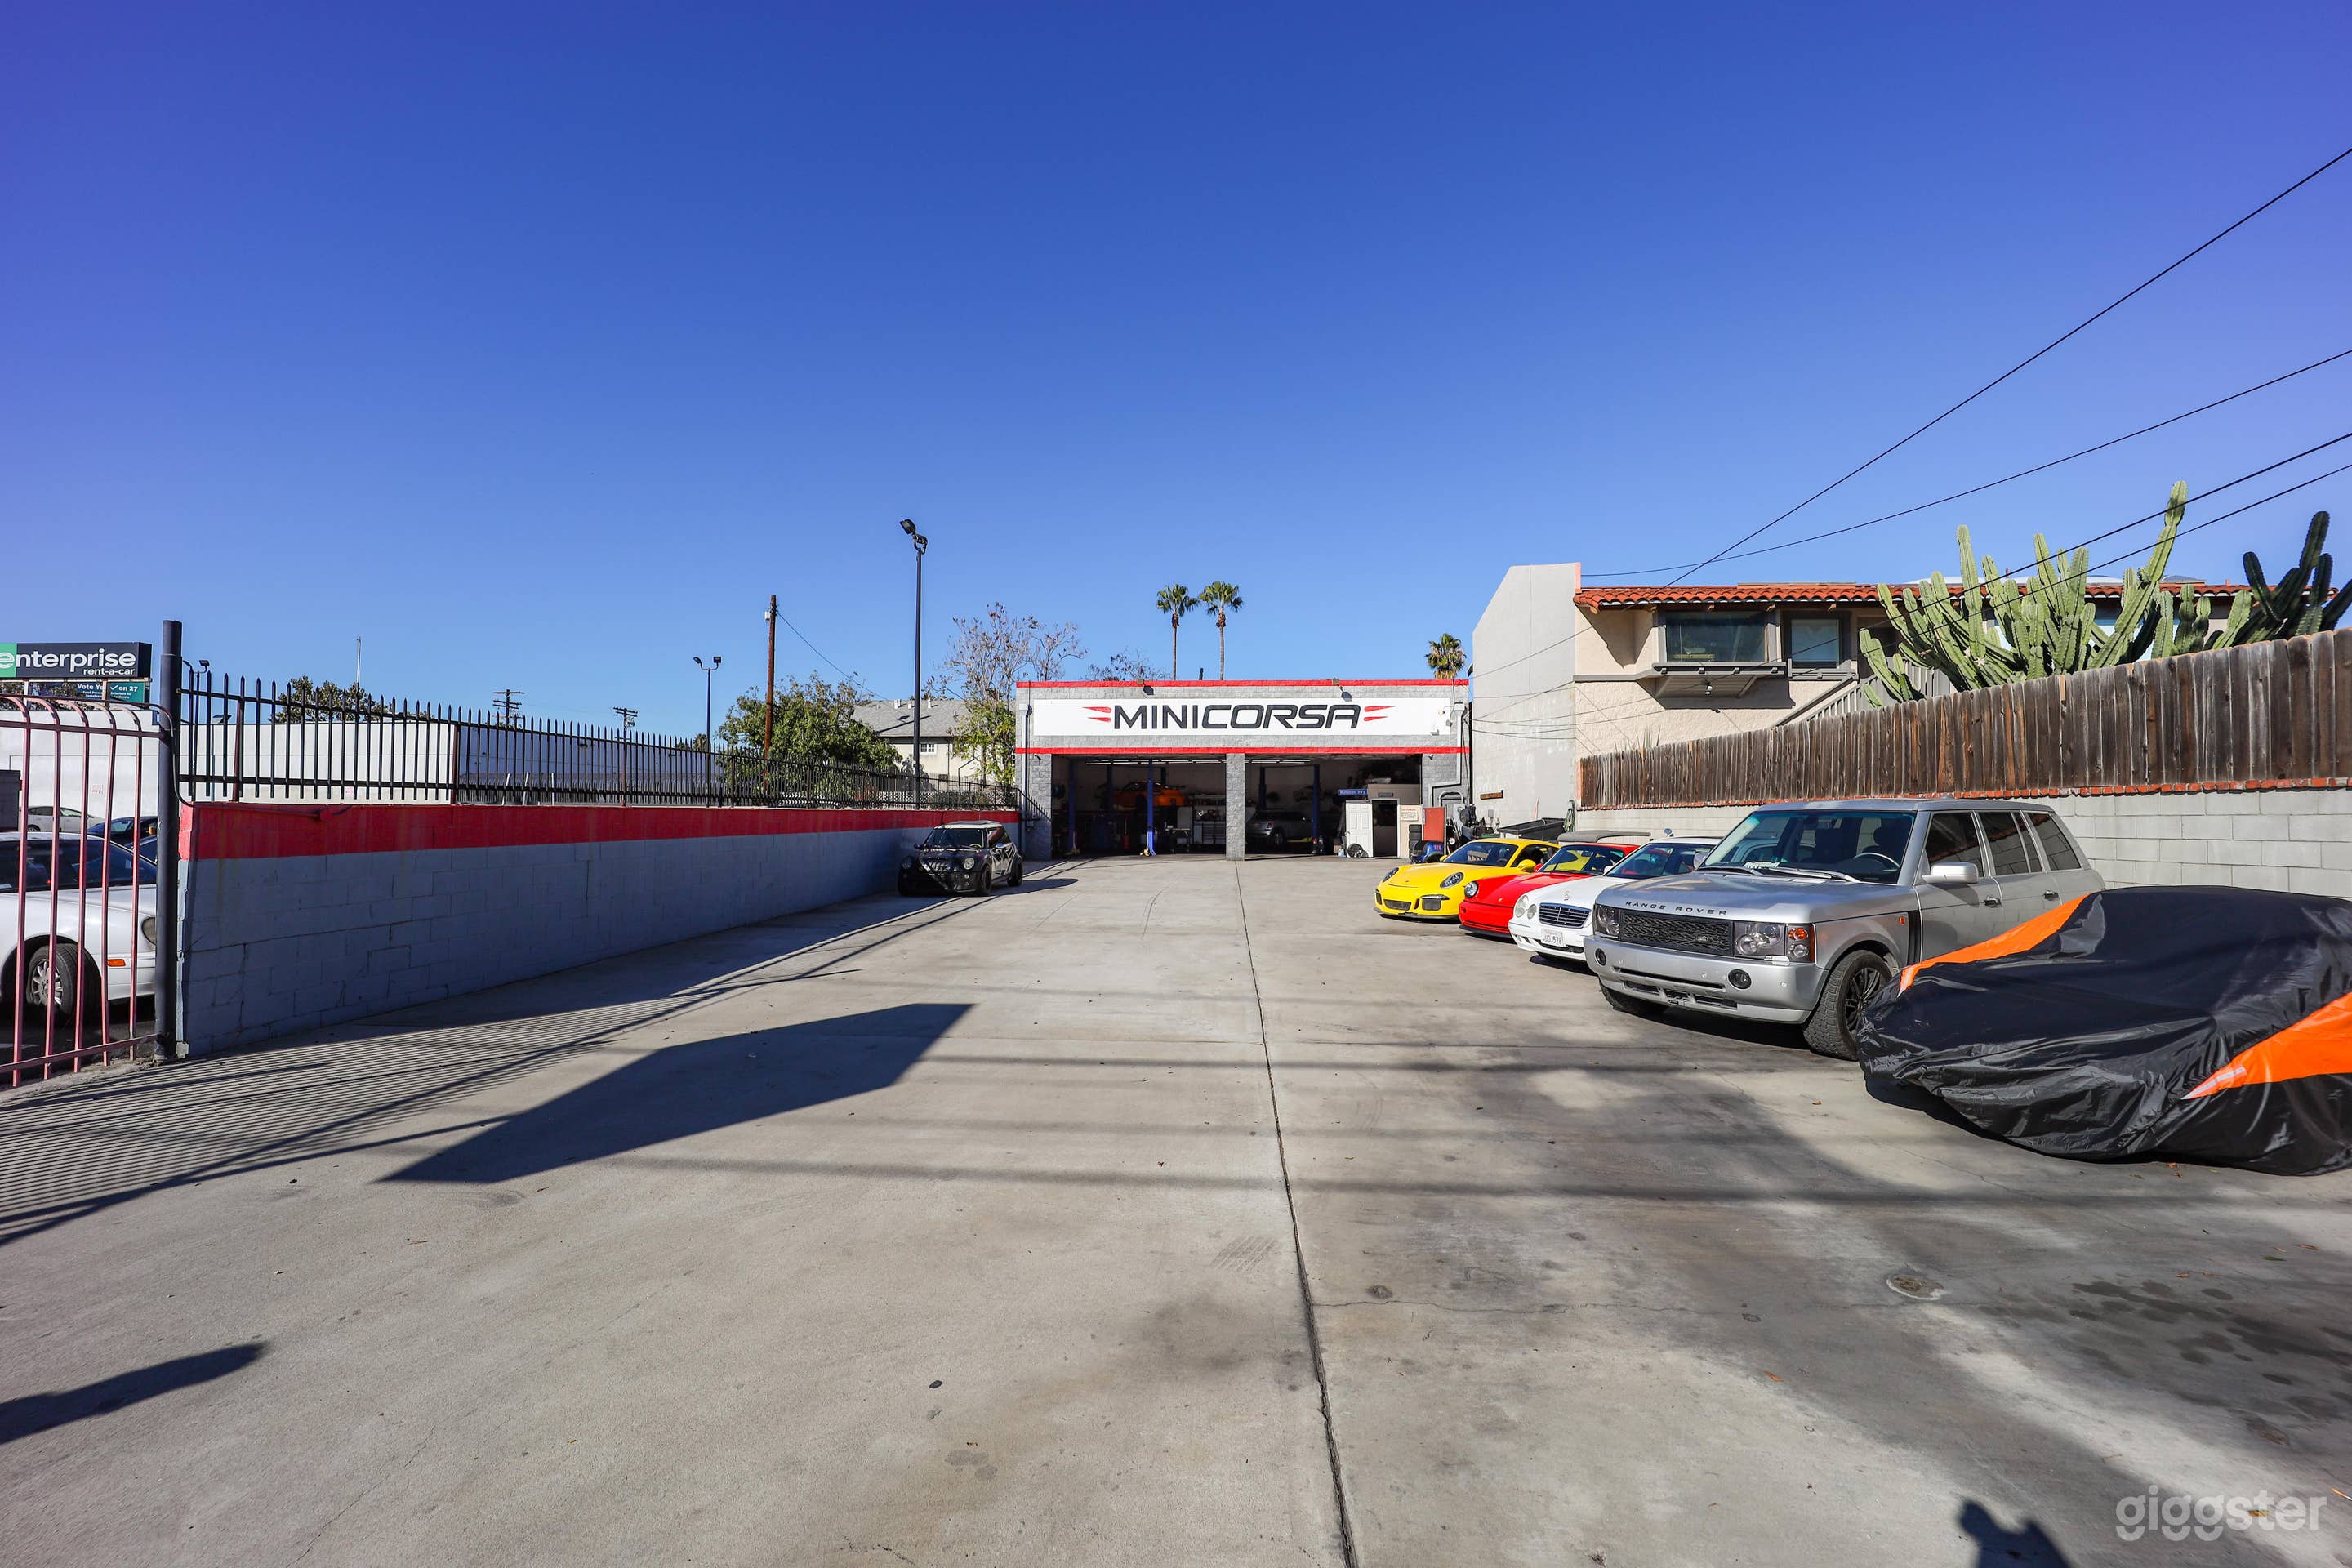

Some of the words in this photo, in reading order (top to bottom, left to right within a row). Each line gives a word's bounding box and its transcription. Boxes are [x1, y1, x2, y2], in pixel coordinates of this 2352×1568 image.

[0, 648, 136, 673] enterprise
[83, 667, 135, 675] rent-a-car
[1114, 705, 1361, 729] MINICORSA
[1625, 901, 1667, 910] RANGE
[1675, 906, 1727, 915] ROVER
